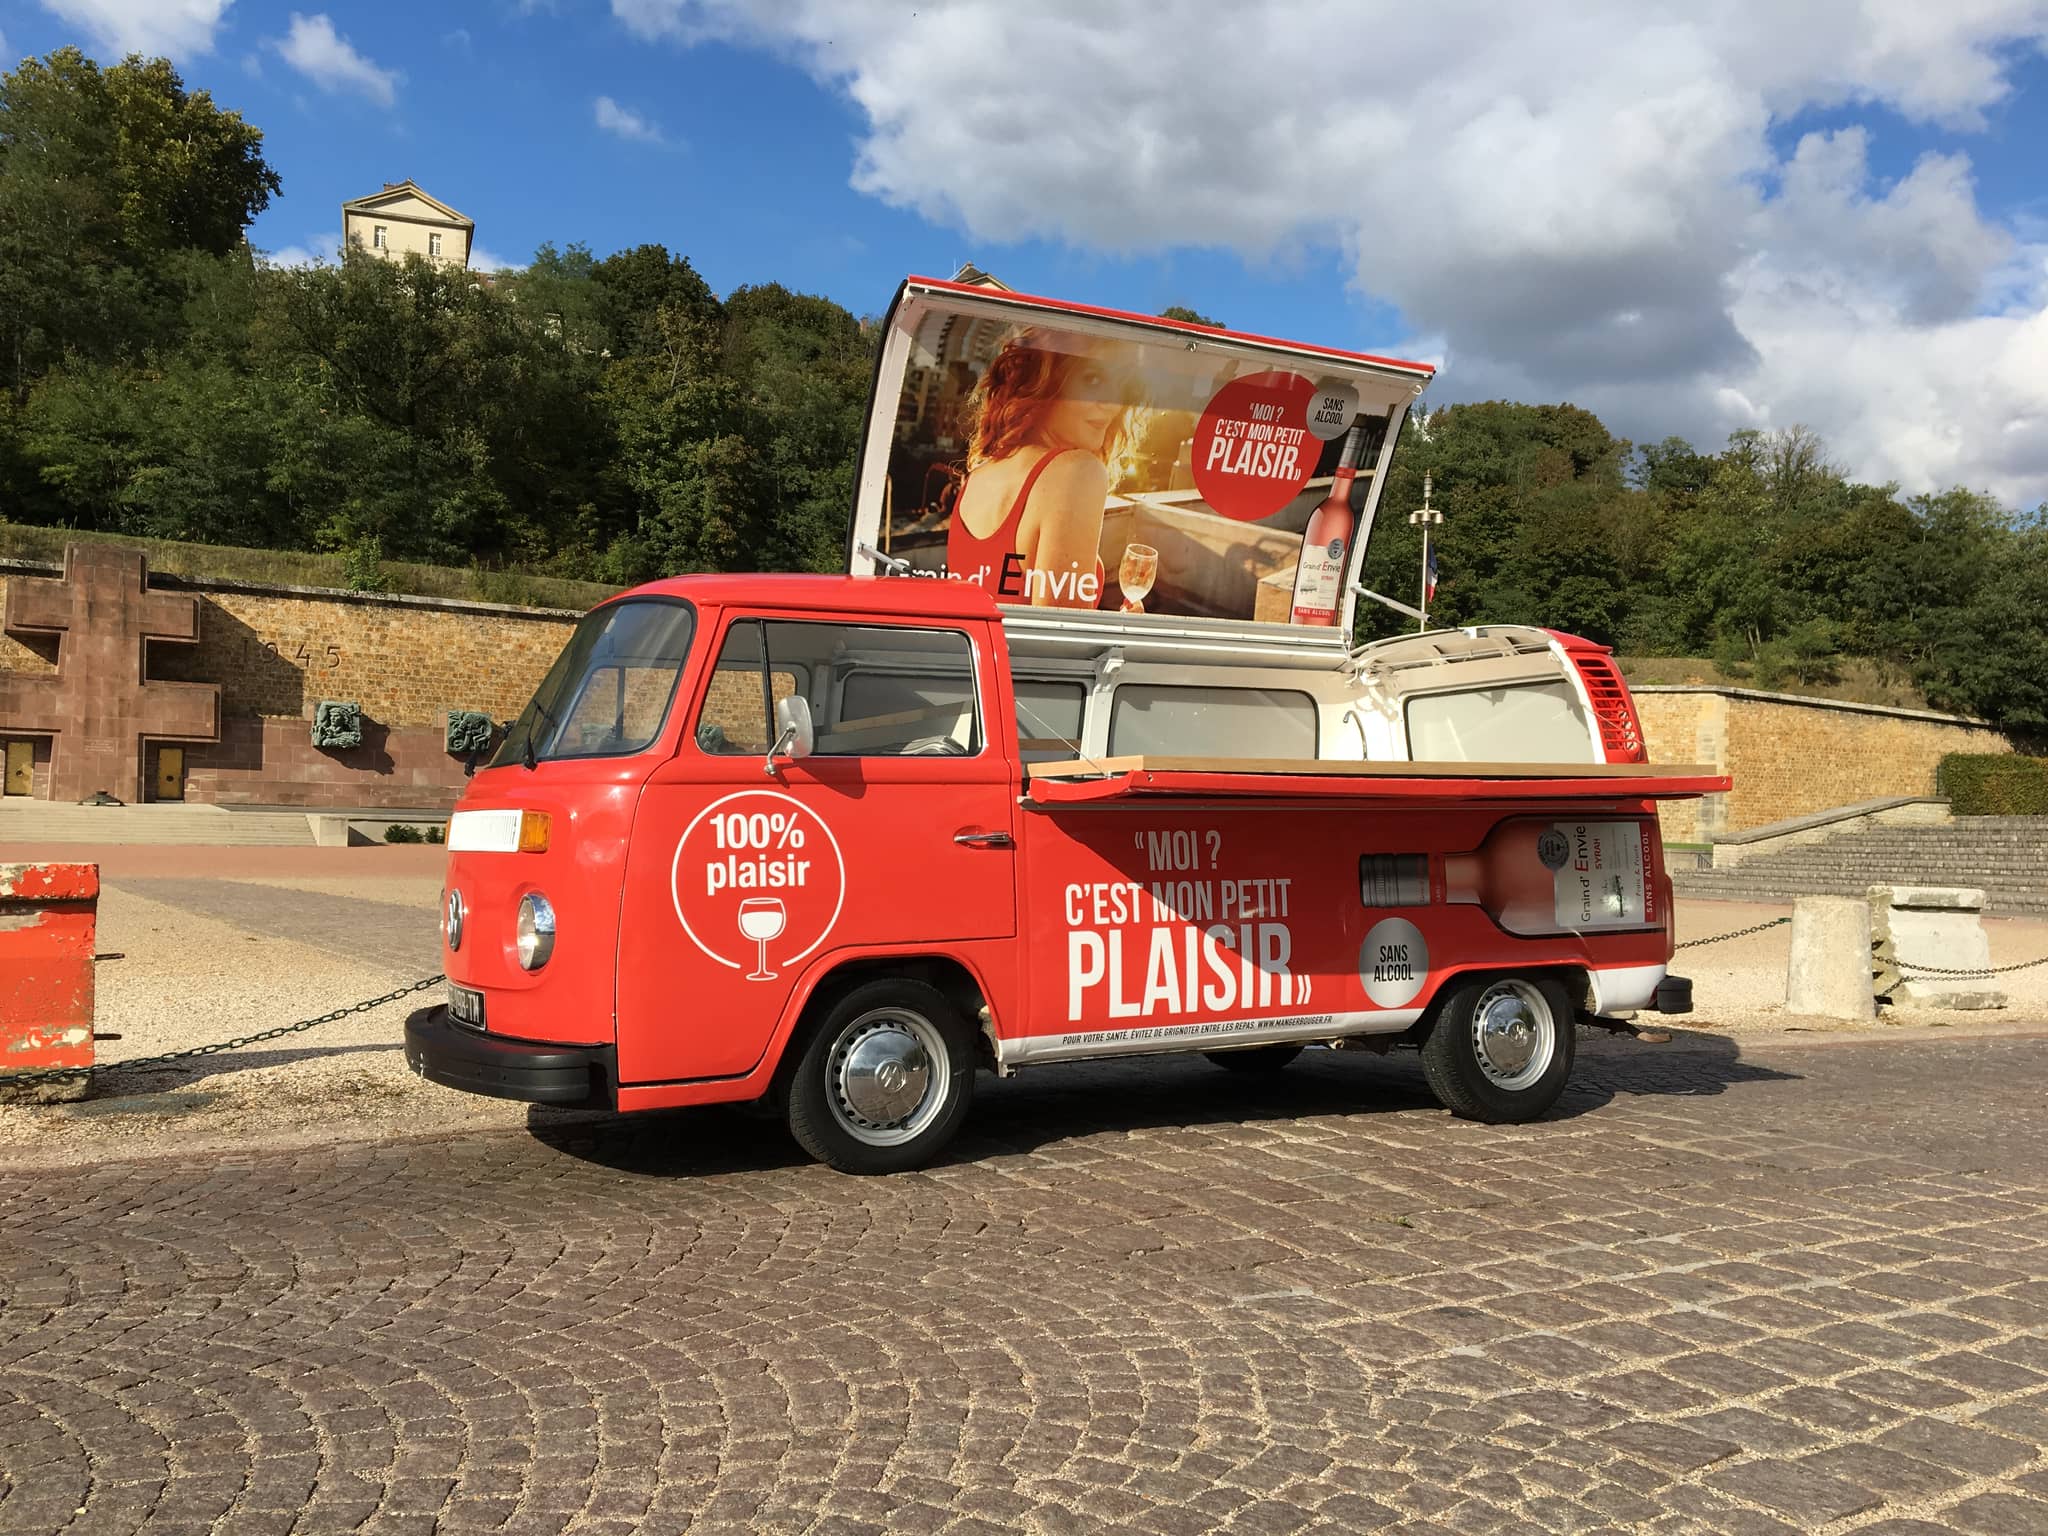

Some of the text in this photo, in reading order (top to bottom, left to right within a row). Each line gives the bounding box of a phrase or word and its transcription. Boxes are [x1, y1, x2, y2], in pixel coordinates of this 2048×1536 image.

[1314, 409, 1344, 425] ALCOOL
[1322, 397, 1345, 412] SANS
[1248, 423, 1273, 441] MON
[1274, 426, 1306, 446] PETIT
[998, 553, 1099, 602] Envie
[709, 812, 805, 849] 100%
[1574, 825, 1589, 872] Envie
[1593, 838, 1602, 870] SYRAH
[706, 854, 811, 896] plaisir
[1642, 832, 1653, 913] SANS ALCOOL
[1152, 880, 1214, 923] MON
[1221, 879, 1291, 920] PETIT
[1380, 944, 1408, 963] SANS
[1374, 963, 1414, 982] ALCOOL
[1062, 1036, 1081, 1045] POUR
[1083, 1034, 1104, 1044] VOTRE
[1154, 1028, 1164, 1038] DE
[1164, 1025, 1200, 1036] GRIGNOTER
[1201, 1023, 1221, 1034] ENTRE
[1222, 1022, 1234, 1032] LES
